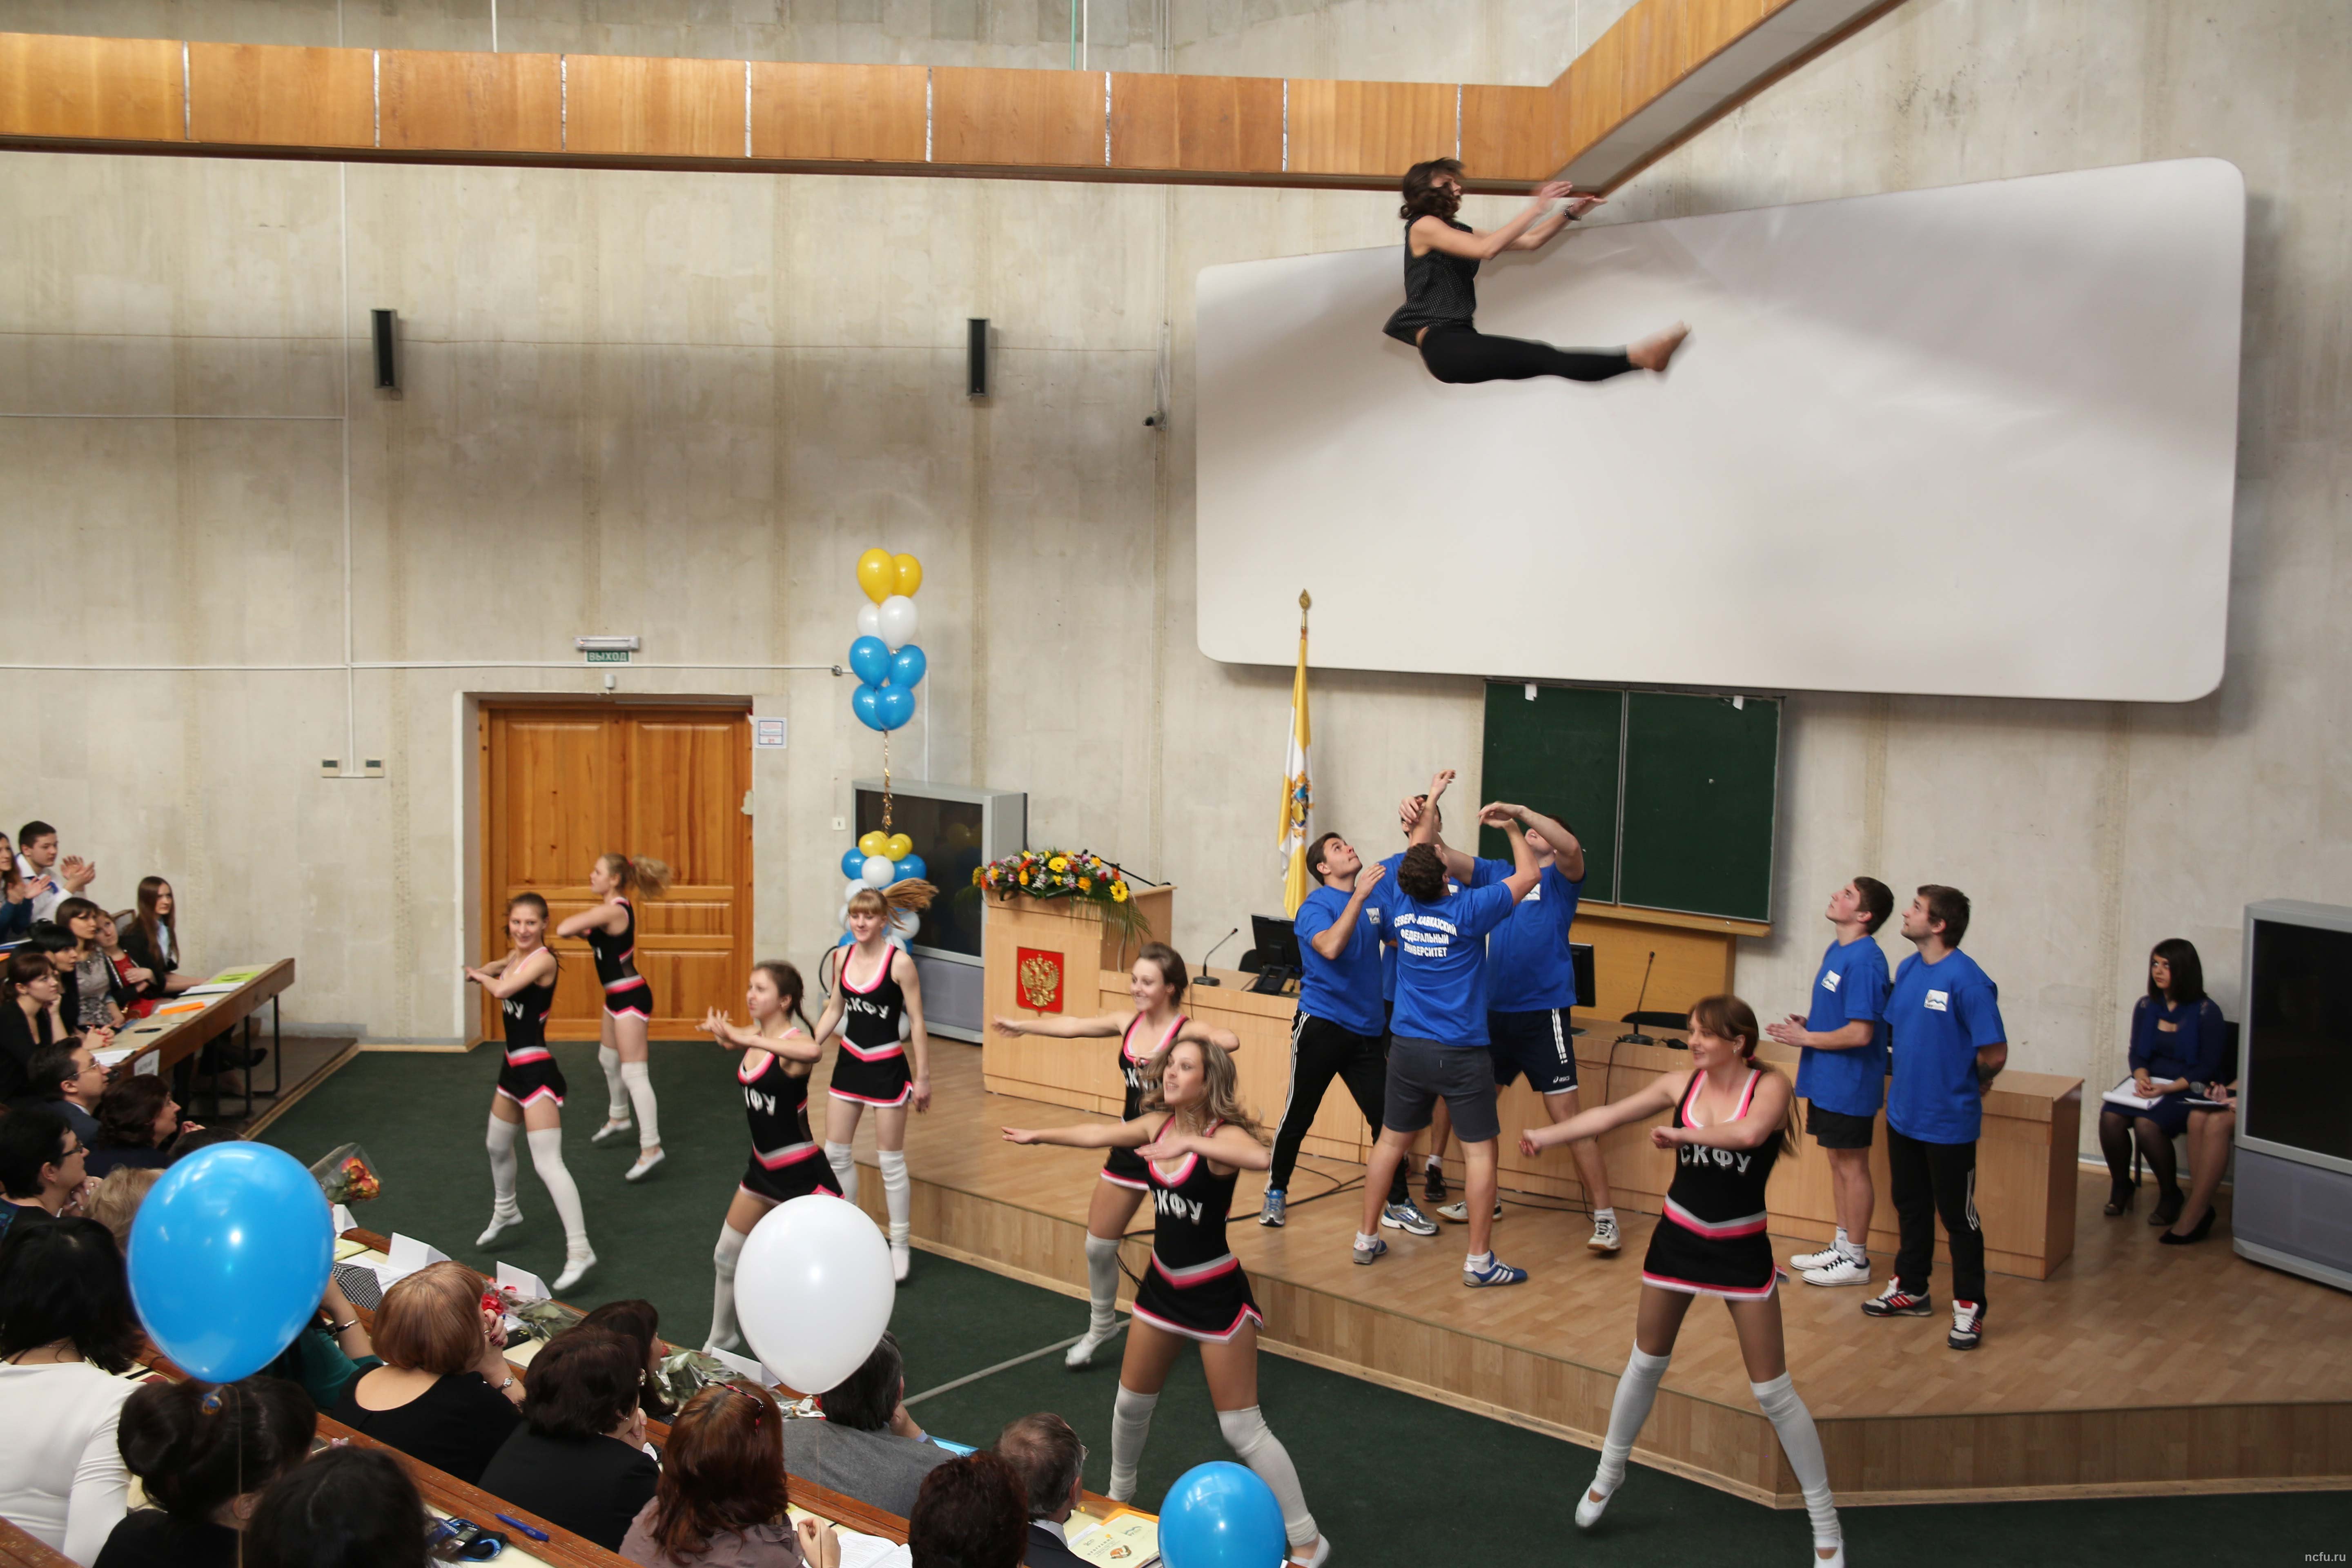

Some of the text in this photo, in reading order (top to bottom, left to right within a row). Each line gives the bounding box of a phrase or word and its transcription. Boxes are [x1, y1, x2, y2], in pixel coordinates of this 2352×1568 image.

[589, 653, 627, 662] ВЫХОД
[1400, 928, 1449, 945] ФЕДЕРАЛЬНЫЙ
[1680, 1144, 1752, 1175] СКФУ
